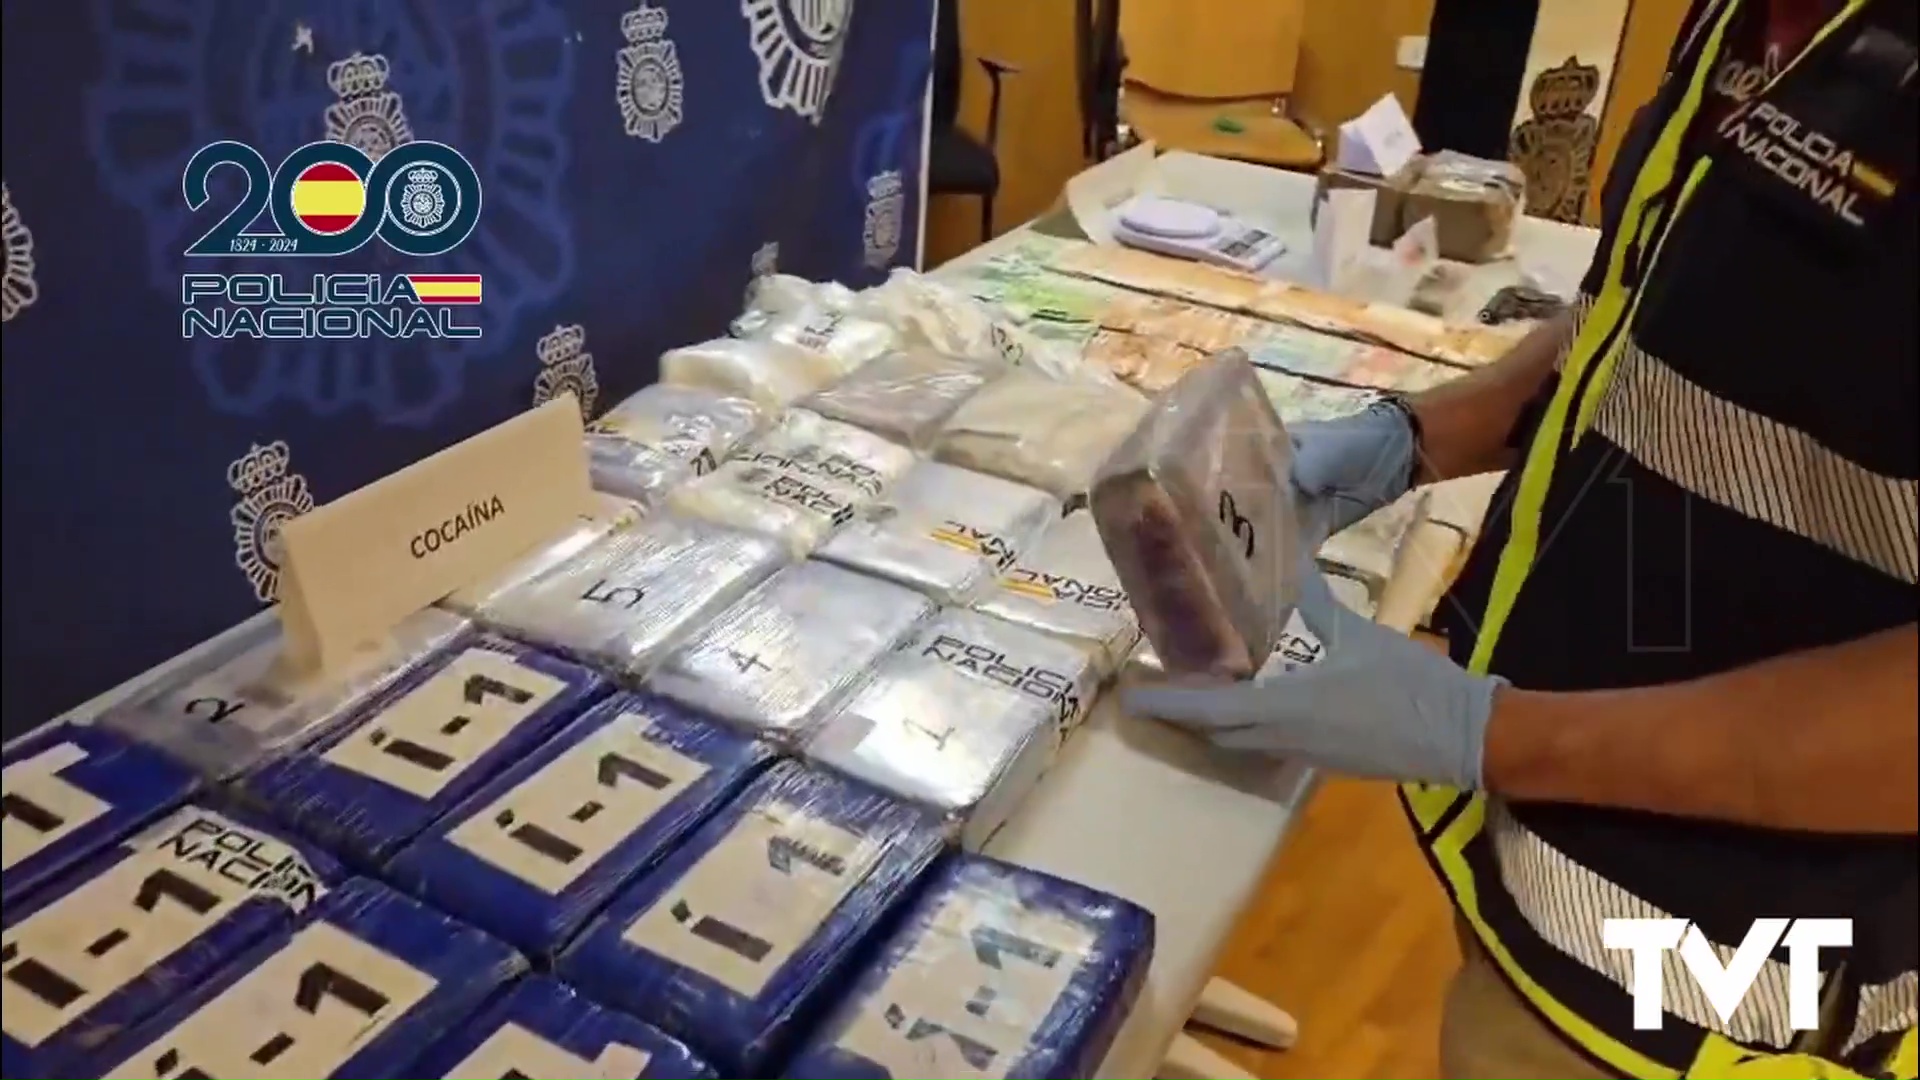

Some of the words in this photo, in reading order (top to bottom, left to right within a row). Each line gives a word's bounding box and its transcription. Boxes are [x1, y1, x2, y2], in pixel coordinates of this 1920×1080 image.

[410, 494, 505, 559] COCAÍNA
[1219, 490, 1255, 560] 3
[582, 579, 646, 610] 5
[184, 696, 246, 724] 2
[494, 751, 673, 865] i-1
